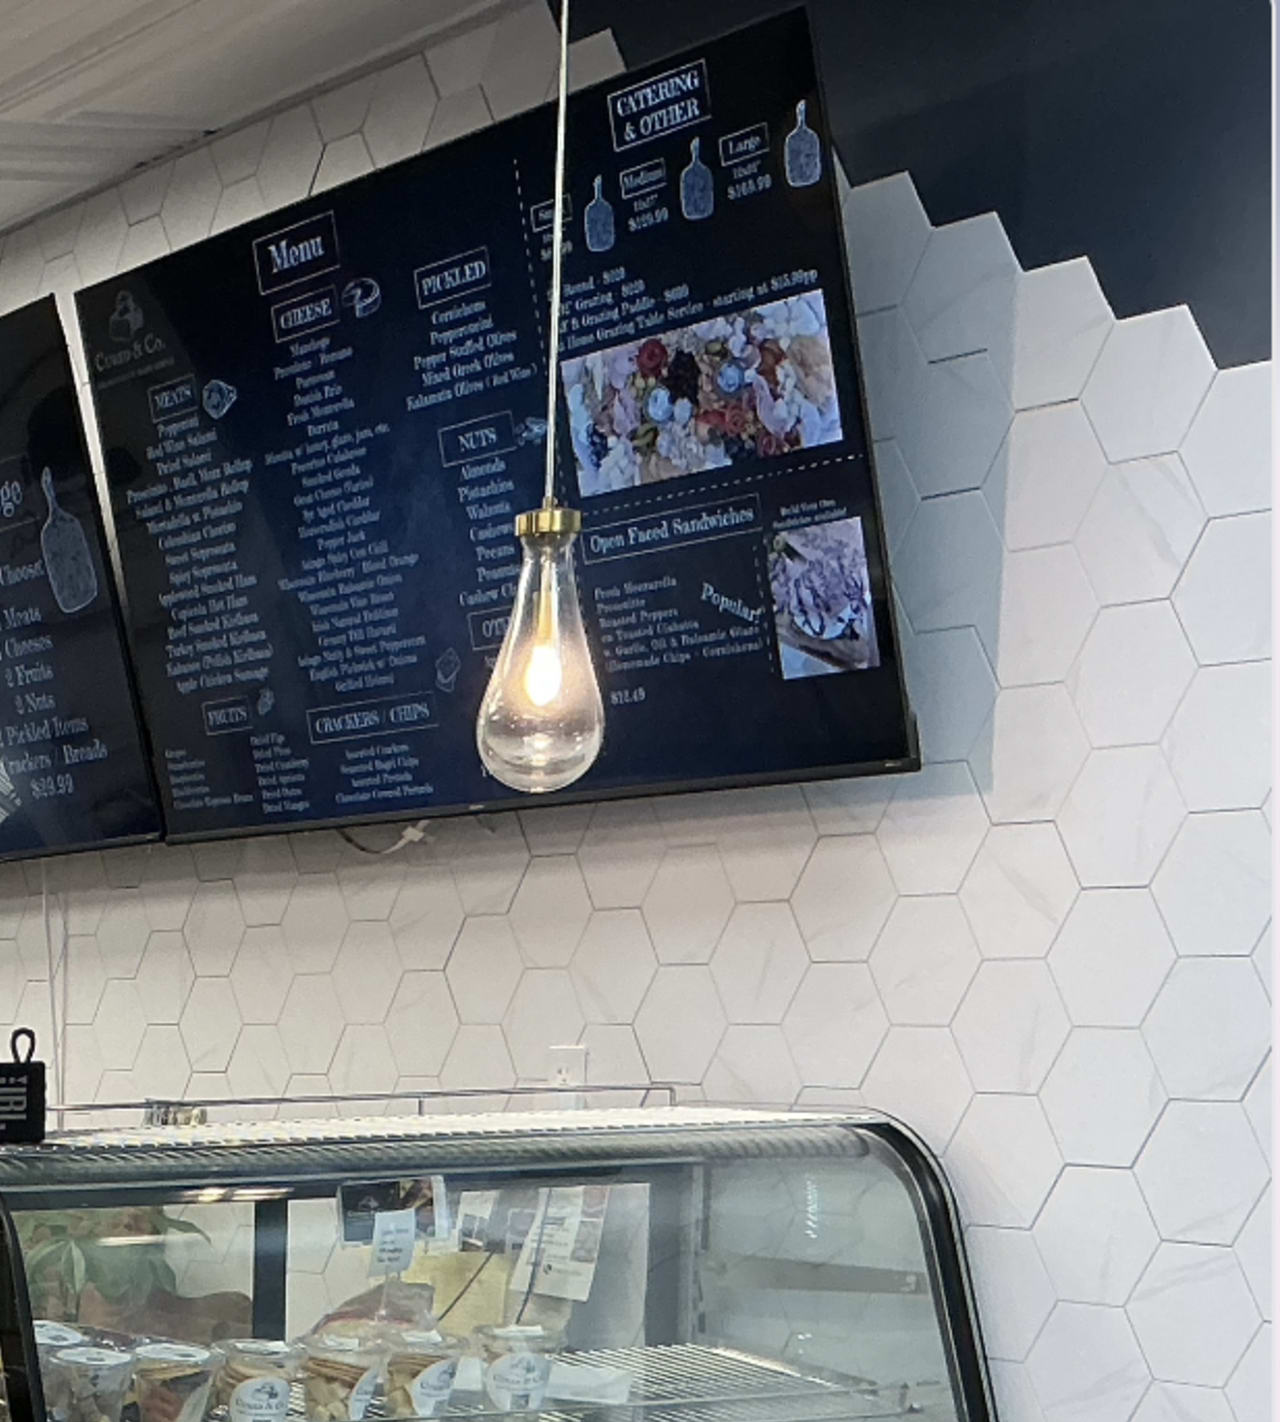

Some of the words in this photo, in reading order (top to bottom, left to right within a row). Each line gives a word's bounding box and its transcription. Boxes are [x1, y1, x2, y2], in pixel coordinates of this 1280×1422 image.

[616, 70, 699, 117] CATERING
[623, 121, 636, 140] &
[639, 97, 698, 134] OTHER
[728, 131, 761, 155] Large
[623, 165, 662, 189] Medium
[267, 227, 323, 273] Menu
[421, 259, 486, 296] PICKLED
[279, 298, 331, 330] CHEESE
[667, 299, 703, 319] Service
[712, 284, 753, 308] starting
[413, 348, 446, 371] Pepper
[448, 337, 484, 359] Stuffed
[485, 327, 516, 347] Olives
[421, 367, 449, 386] Mixed
[451, 358, 480, 377] Greek
[482, 347, 513, 368] Olives
[154, 384, 192, 409] MEATS
[454, 378, 482, 396] Olives
[457, 427, 496, 451] NUTS
[460, 457, 505, 479] Almonds
[465, 498, 510, 520] Walnuts
[589, 531, 625, 555] Open
[627, 522, 667, 544] Faced
[671, 503, 753, 536] Sandwiches
[476, 541, 514, 560] Pecans
[594, 585, 620, 599] Fresh
[701, 583, 763, 623] Popular!
[1, 602, 41, 629] Meats
[598, 613, 636, 628] Roasted
[639, 606, 677, 622] Peppers
[4, 631, 53, 659] Cheeses
[662, 650, 689, 664] Chips
[15, 660, 52, 686] Fruits
[25, 690, 55, 713] Nuts
[207, 706, 247, 724] FRUITS
[315, 710, 379, 732] CRACKERS
[389, 703, 429, 721] CHIPS
[5, 718, 54, 746] Pickled
[54, 711, 87, 736] Items
[62, 738, 107, 763] Breads
